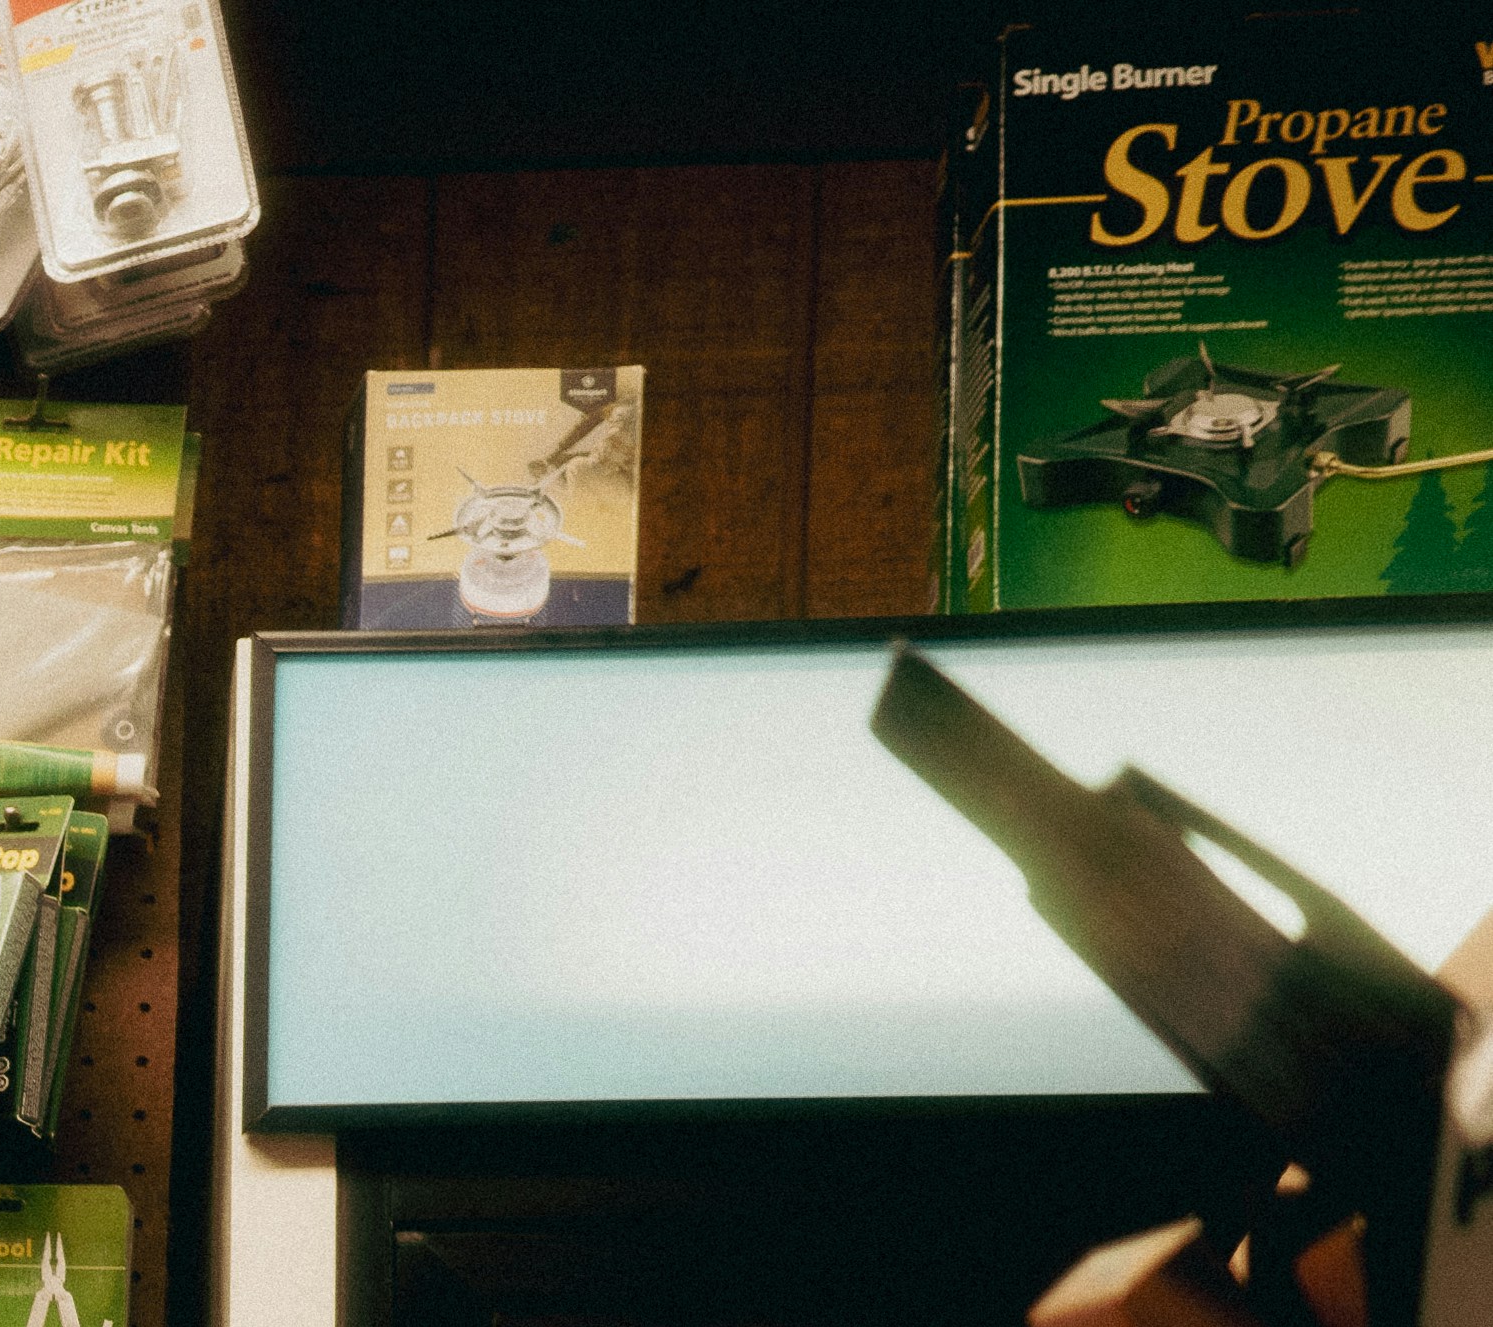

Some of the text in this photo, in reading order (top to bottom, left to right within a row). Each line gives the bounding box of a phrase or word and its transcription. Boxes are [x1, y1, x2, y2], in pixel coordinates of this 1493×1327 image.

[1011, 61, 1219, 100] Single Burner
[1217, 99, 1448, 155] Propane
[1089, 121, 1468, 248] Stove
[102, 440, 152, 468] Kit
